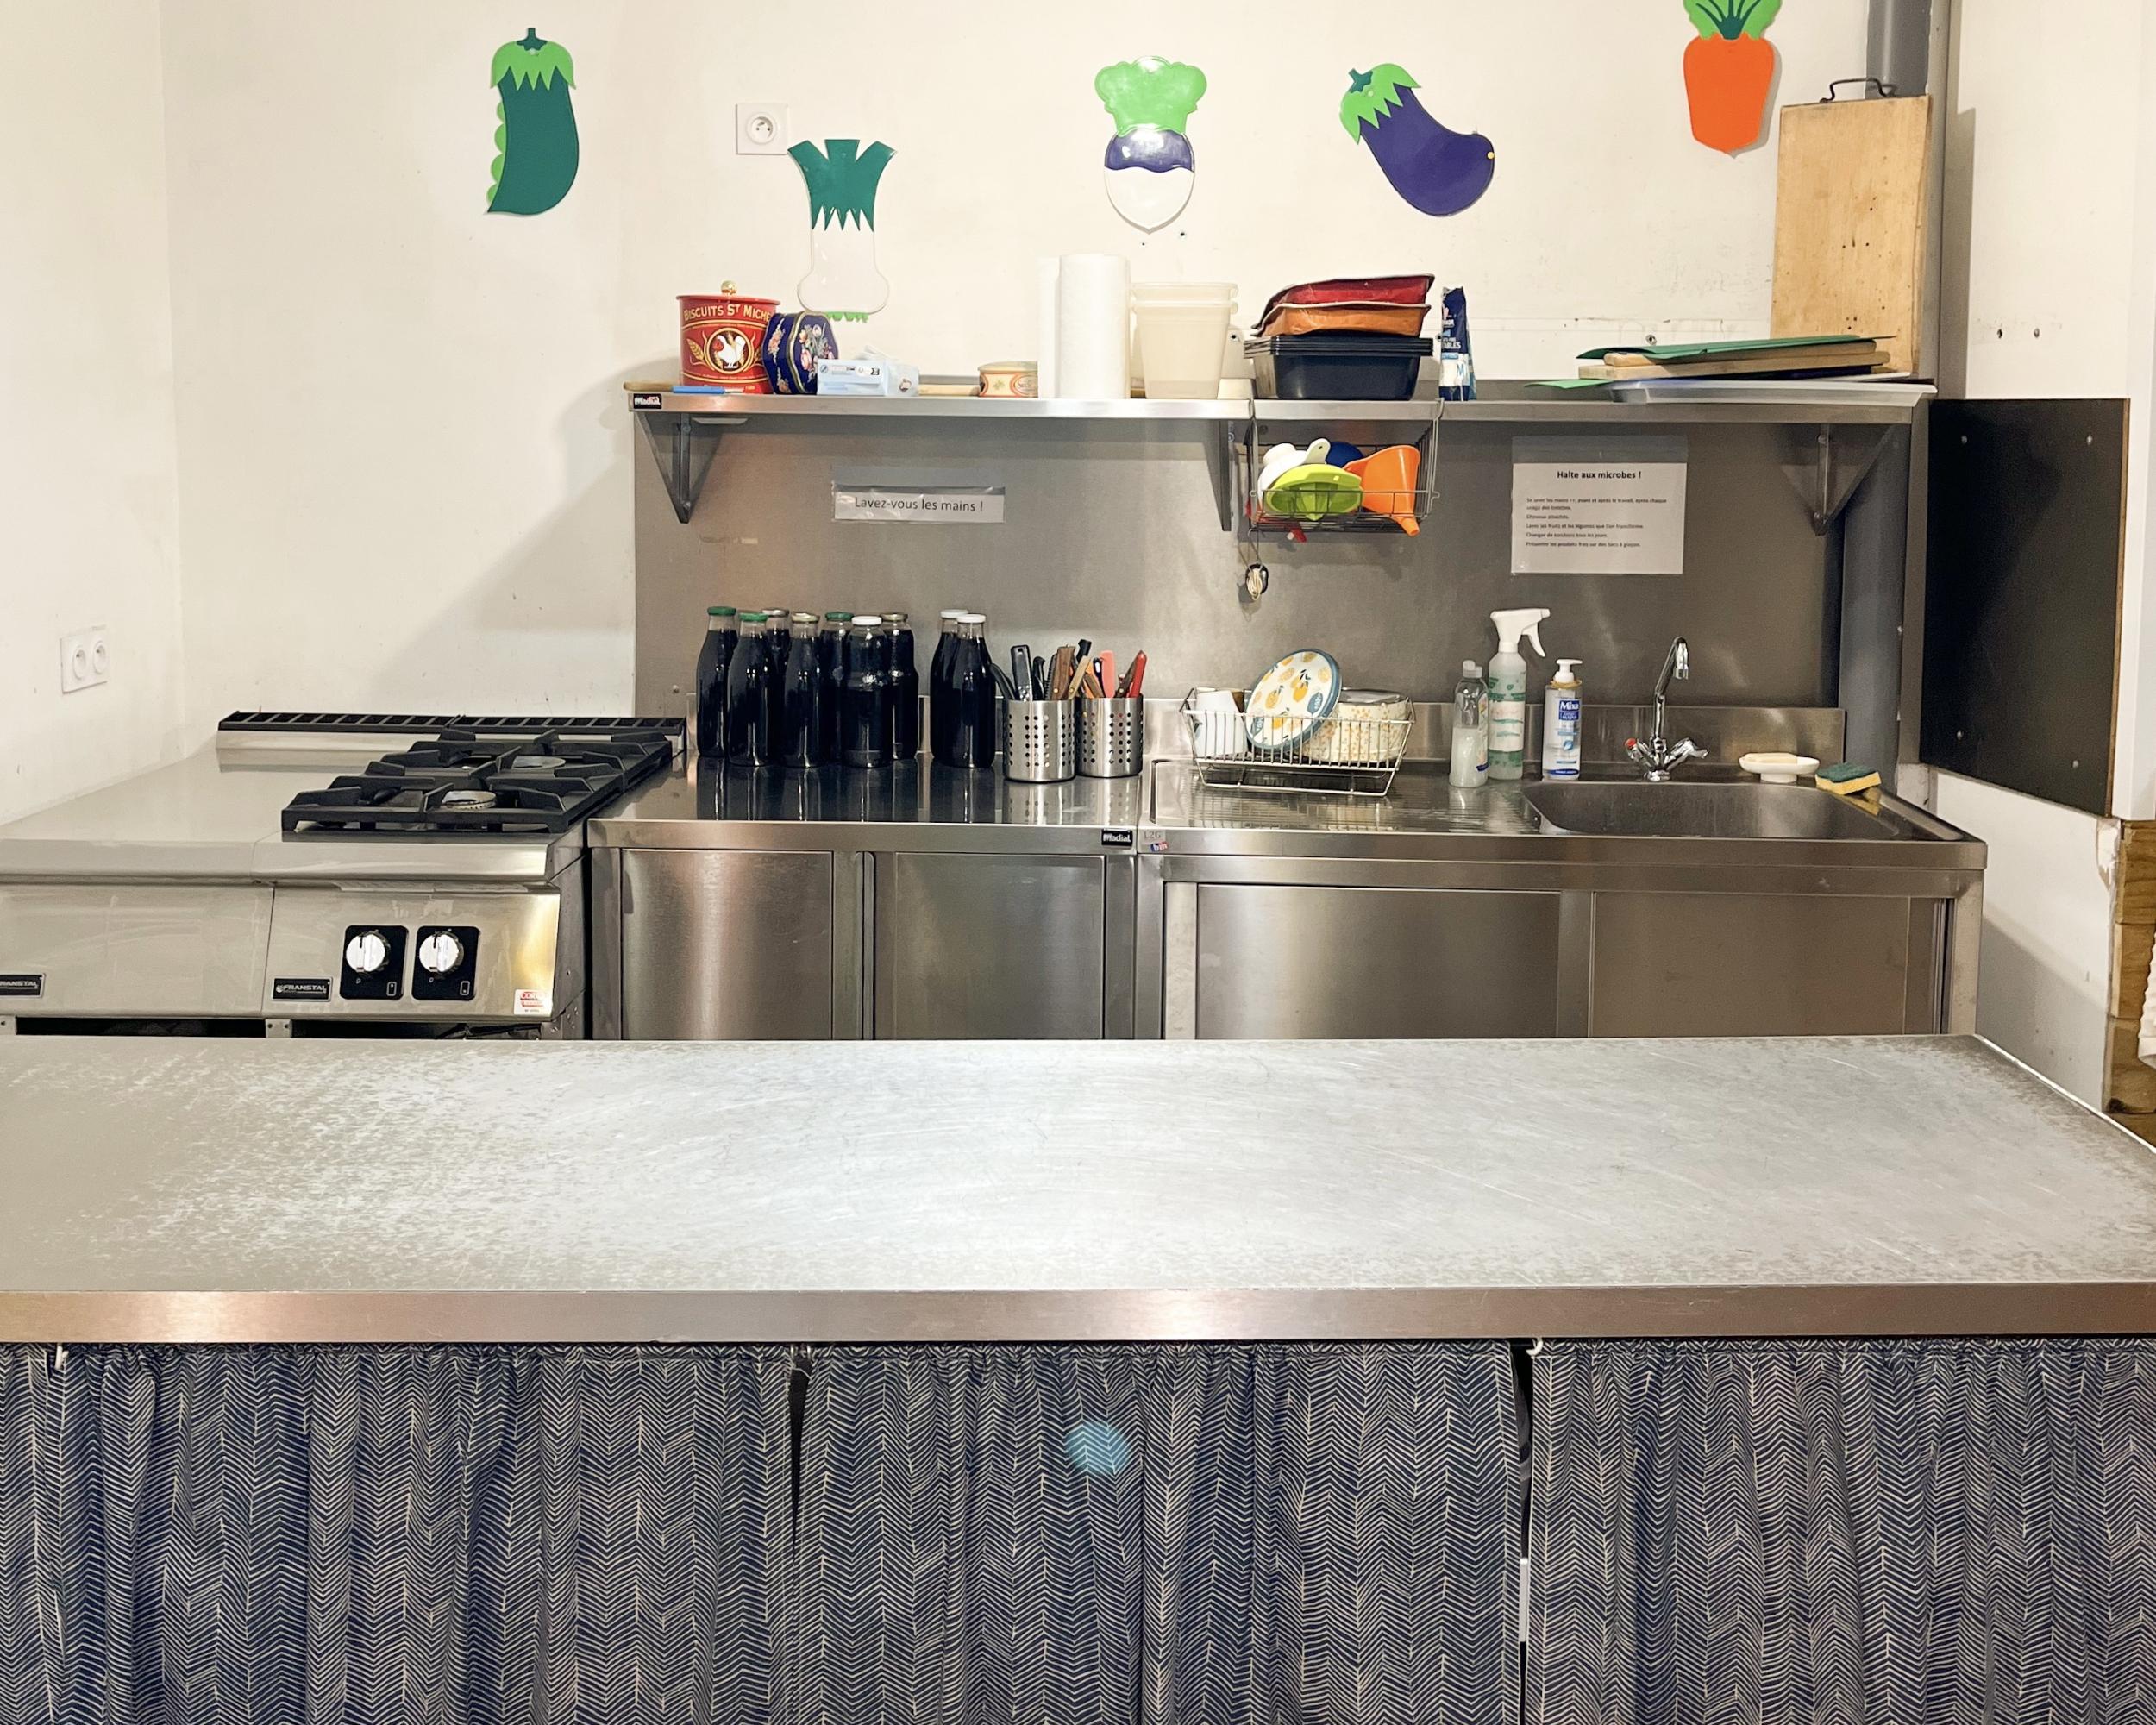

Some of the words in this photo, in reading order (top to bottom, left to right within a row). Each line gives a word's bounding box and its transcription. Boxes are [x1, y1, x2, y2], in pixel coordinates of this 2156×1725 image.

[684, 304, 724, 322] BISCUITS
[743, 304, 771, 322] MICHE
[1557, 470, 1579, 479] Halte
[1597, 470, 1636, 479] microbes
[855, 496, 918, 510] Lavez-vous
[921, 498, 937, 511] les
[941, 499, 975, 511] mains
[979, 500, 984, 511] !
